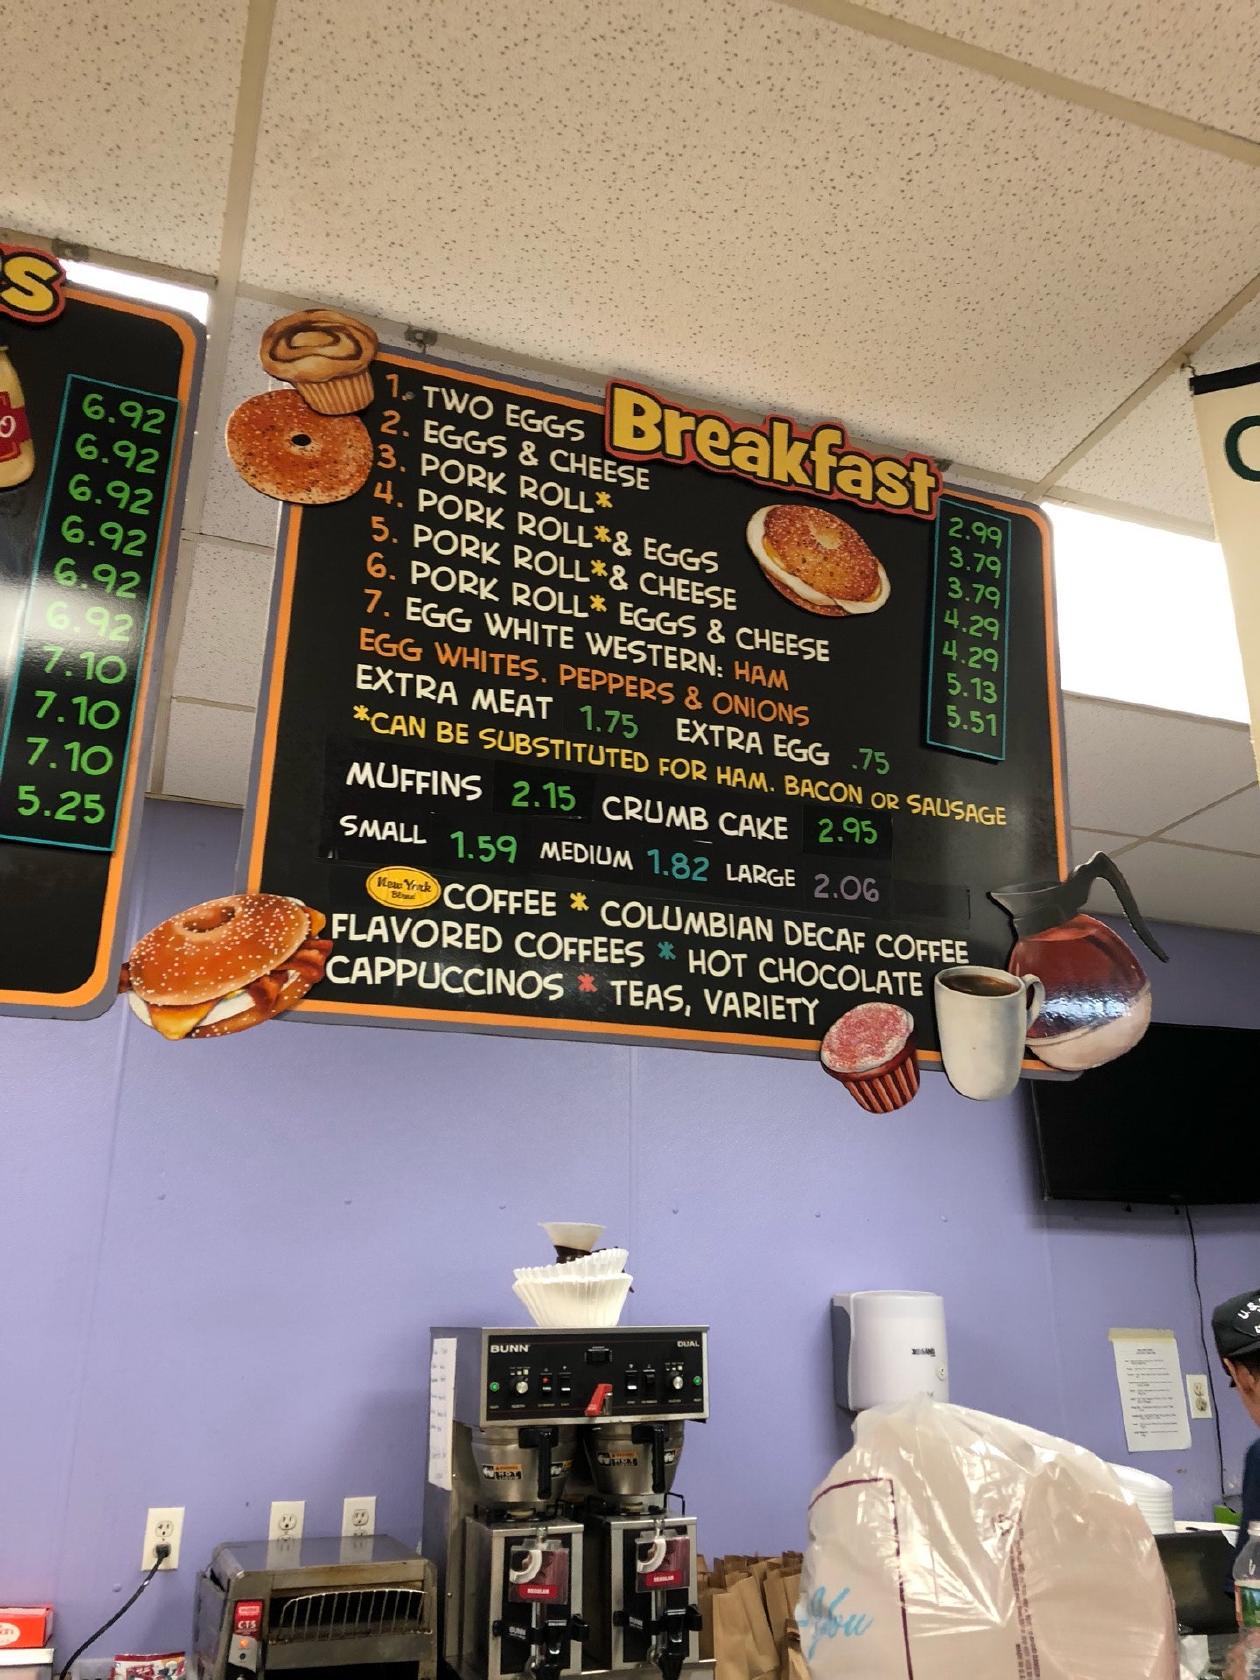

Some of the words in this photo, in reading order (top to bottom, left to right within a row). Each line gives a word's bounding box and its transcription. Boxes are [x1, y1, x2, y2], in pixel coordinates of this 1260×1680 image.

[82, 394, 166, 435] 6.92
[422, 385, 494, 421] TWO
[505, 403, 585, 441] EGGS
[75, 433, 160, 474] 6.92
[377, 444, 405, 472] 3.
[421, 453, 507, 495] PORK
[380, 409, 409, 437] 2.
[423, 420, 507, 458] EGGS
[518, 441, 538, 466] &
[549, 449, 650, 490] CHEESE
[612, 386, 936, 514] Breakfast
[68, 473, 154, 515] 6.92
[61, 514, 148, 556] 6.92
[373, 481, 403, 507] 4.
[418, 488, 504, 531] PORK
[612, 531, 632, 557] &
[643, 537, 720, 574] EGGS
[948, 517, 1003, 549] 2.99
[54, 558, 141, 599] 6.92
[371, 516, 398, 543] 5.
[413, 524, 500, 566] PORK
[608, 565, 629, 591] &
[639, 572, 737, 611] CHEESE
[948, 547, 1002, 579] 3.79
[366, 552, 396, 580] 6.
[411, 561, 500, 602] PORK
[619, 602, 696, 638] EGGS
[706, 618, 726, 644] &
[736, 626, 830, 662] CHEESE
[948, 578, 1001, 609] 3.79
[46, 601, 134, 642] 6.92
[363, 589, 390, 617] 7.
[405, 597, 472, 633] EGG
[484, 612, 575, 649] WHITE
[586, 631, 723, 678] WESTERN:
[734, 660, 789, 691] HAM
[943, 608, 1000, 641] 4.29
[44, 645, 128, 684] 7.10
[942, 640, 999, 672] 4.29
[359, 628, 423, 662] EGG
[559, 665, 675, 705] PEPPERS
[684, 686, 703, 710] &
[712, 692, 810, 727] ONIONS
[946, 672, 998, 704] 5.13
[34, 690, 120, 730] 7.10
[356, 664, 458, 706] EXTRA
[472, 688, 553, 720] MEAT
[579, 705, 639, 739] 1.75
[676, 718, 763, 755] EXTRA
[774, 734, 830, 766] EGG
[852, 748, 890, 773] .75
[946, 706, 998, 737] 5.51
[26, 736, 114, 776] 7.10
[436, 721, 469, 745] BE
[479, 728, 649, 773] SUBSTITUTED
[659, 757, 707, 781] FOR
[784, 775, 863, 805] BACON
[871, 792, 899, 810] OR
[906, 793, 1007, 826] SAUSAGE
[18, 785, 106, 824] 5.25
[346, 762, 482, 801] MUFFINS
[511, 781, 576, 811] 2.15
[602, 796, 709, 831] CRUMB
[719, 811, 788, 840] CAKE
[818, 816, 878, 844] 2.95
[339, 815, 427, 845] SMALL
[450, 830, 517, 864] 1.59
[540, 841, 634, 870] MEDIUM
[647, 847, 710, 882] 1.82
[725, 863, 796, 887] LARGE
[813, 873, 879, 901] 2.06
[377, 876, 403, 890] New
[403, 879, 432, 893] York
[443, 883, 557, 917] COFFEE
[601, 901, 774, 942] COLUMBIAN
[784, 919, 866, 955] DECAF
[875, 933, 969, 964] COFFEE
[332, 913, 502, 953] FLAVORED
[515, 932, 645, 968] COFFEES
[688, 949, 748, 978] HOT
[758, 957, 923, 997] CHOCOLATE
[325, 955, 565, 1001] CAPPUCCINOS
[610, 979, 692, 1016] TEAS,
[704, 988, 819, 1025] VARIETY
[490, 1344, 530, 1354] BUNN
[677, 1340, 700, 1348] DUAL
